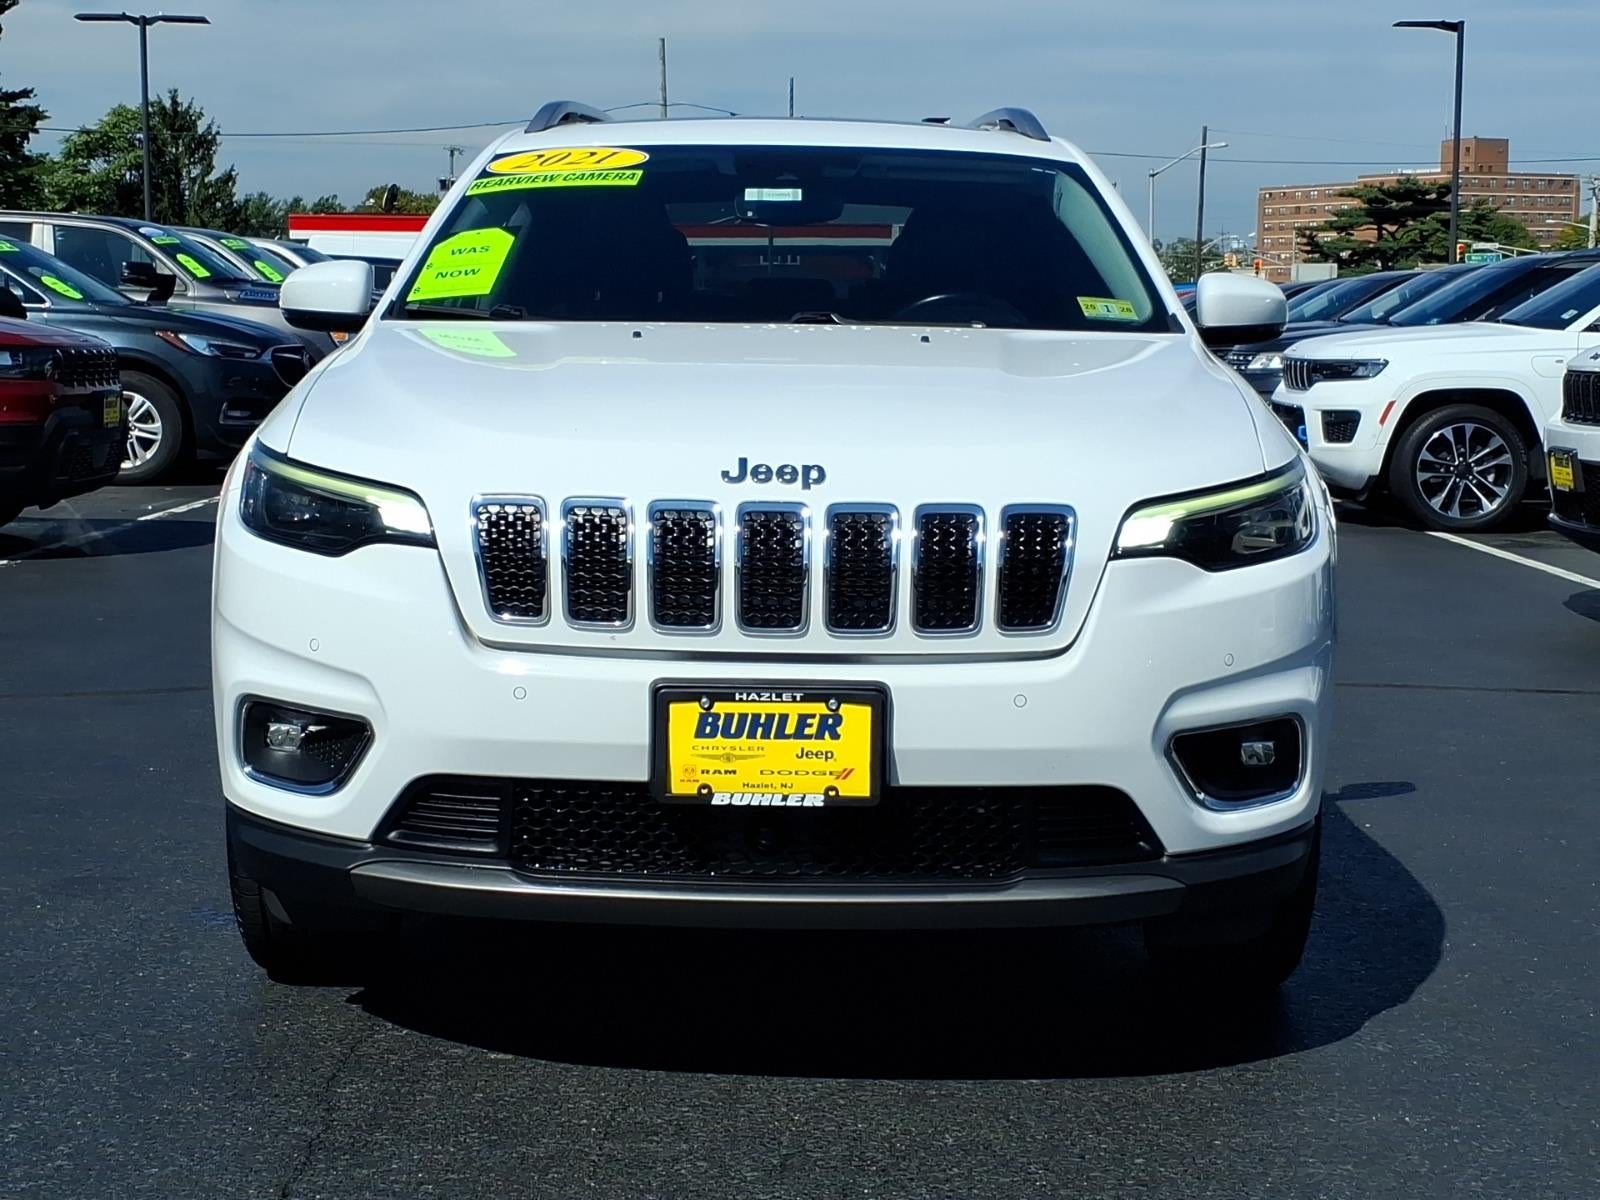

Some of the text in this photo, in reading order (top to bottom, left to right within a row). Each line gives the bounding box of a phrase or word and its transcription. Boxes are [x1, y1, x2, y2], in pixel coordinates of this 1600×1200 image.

[512, 151, 621, 170] 2021
[471, 171, 637, 190] REARVIEW CAMERA
[450, 245, 491, 256] WAS
[434, 268, 481, 279] NOW
[721, 457, 826, 490] Jeep
[735, 692, 804, 702] HAZLET
[694, 711, 843, 741] BUHLER
[691, 744, 765, 752] CHRYSLER
[795, 747, 834, 762] Jeep
[700, 768, 737, 776] RAM
[711, 792, 825, 807] BUHLER
